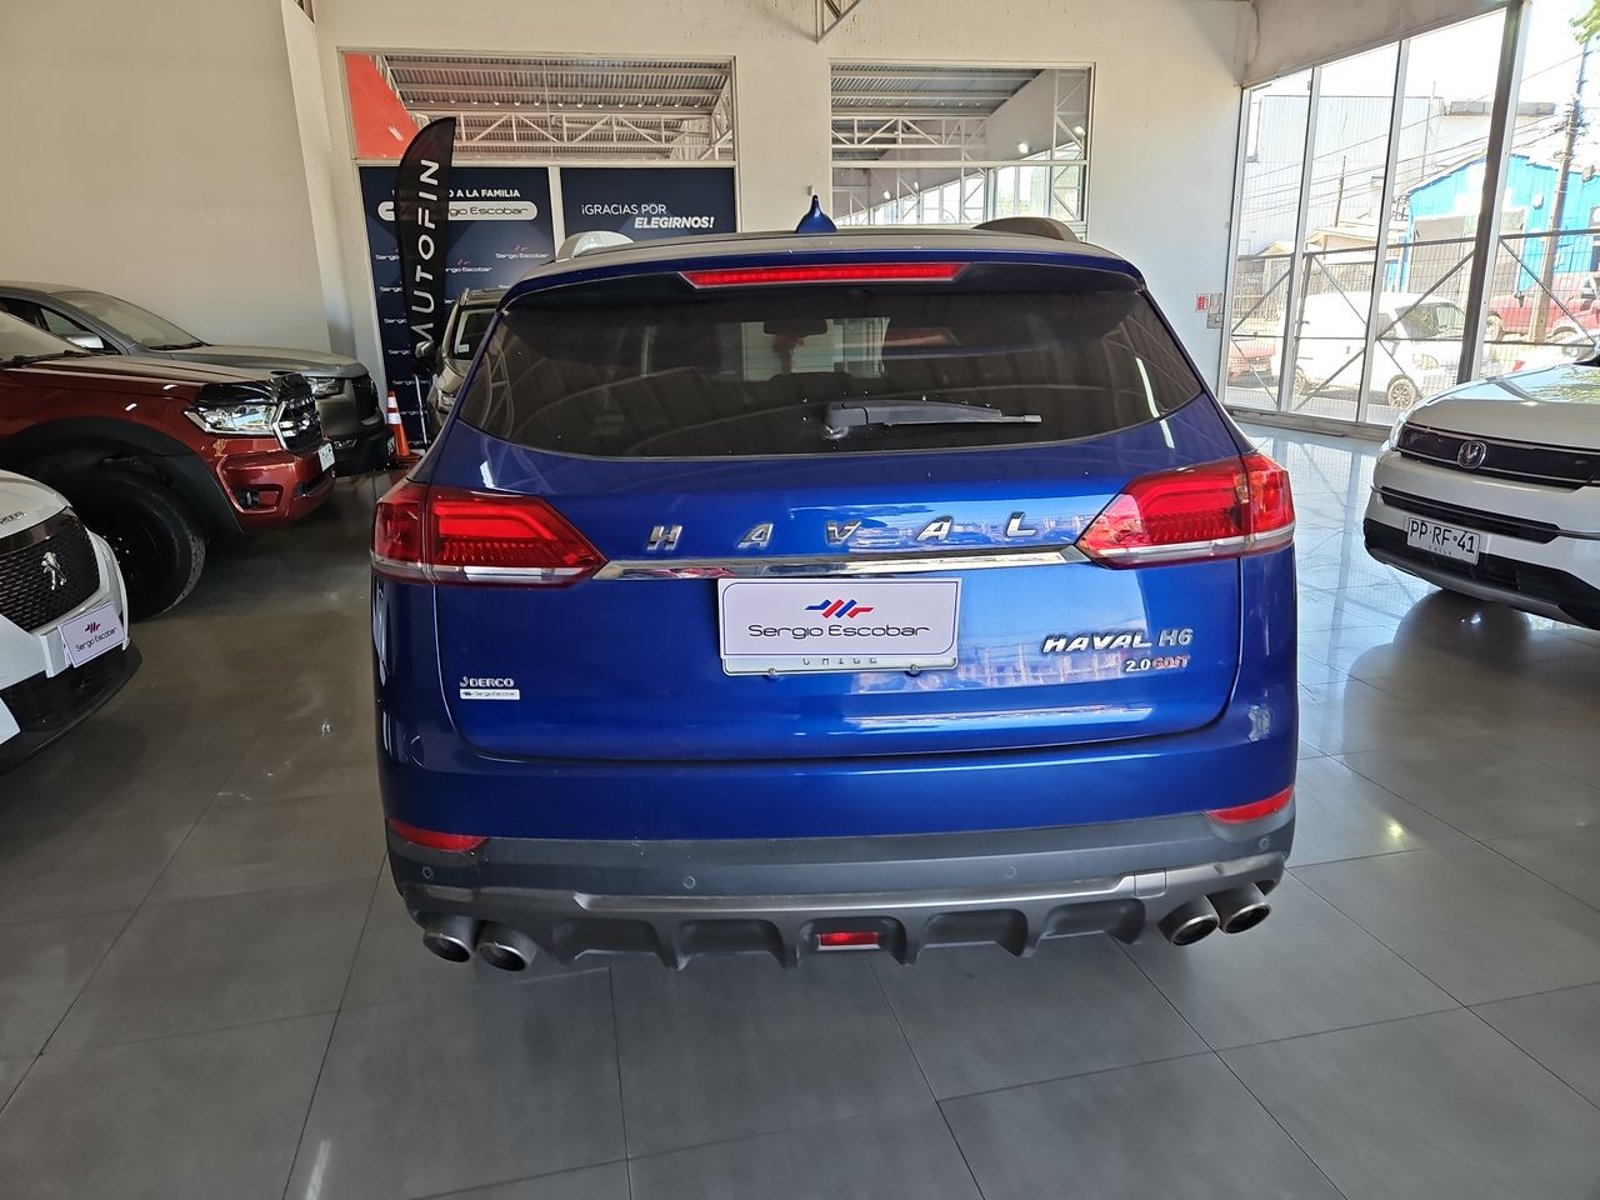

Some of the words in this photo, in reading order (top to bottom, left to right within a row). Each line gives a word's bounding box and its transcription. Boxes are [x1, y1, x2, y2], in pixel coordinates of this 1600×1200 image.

[456, 189, 465, 198] A
[465, 189, 480, 198] LA
[481, 189, 521, 198] FAMILIA
[469, 206, 529, 216] Escobar
[581, 204, 639, 216] ¡GRACIAS
[641, 204, 667, 215] POR
[634, 216, 715, 229] ELEGIRNOS!
[410, 159, 440, 341] AUTOFIN
[646, 511, 1037, 552] HAVAL
[748, 624, 824, 640] Sergio
[828, 624, 930, 637] Escobar
[1043, 633, 1152, 654] HAVAL
[1158, 628, 1194, 647] H6
